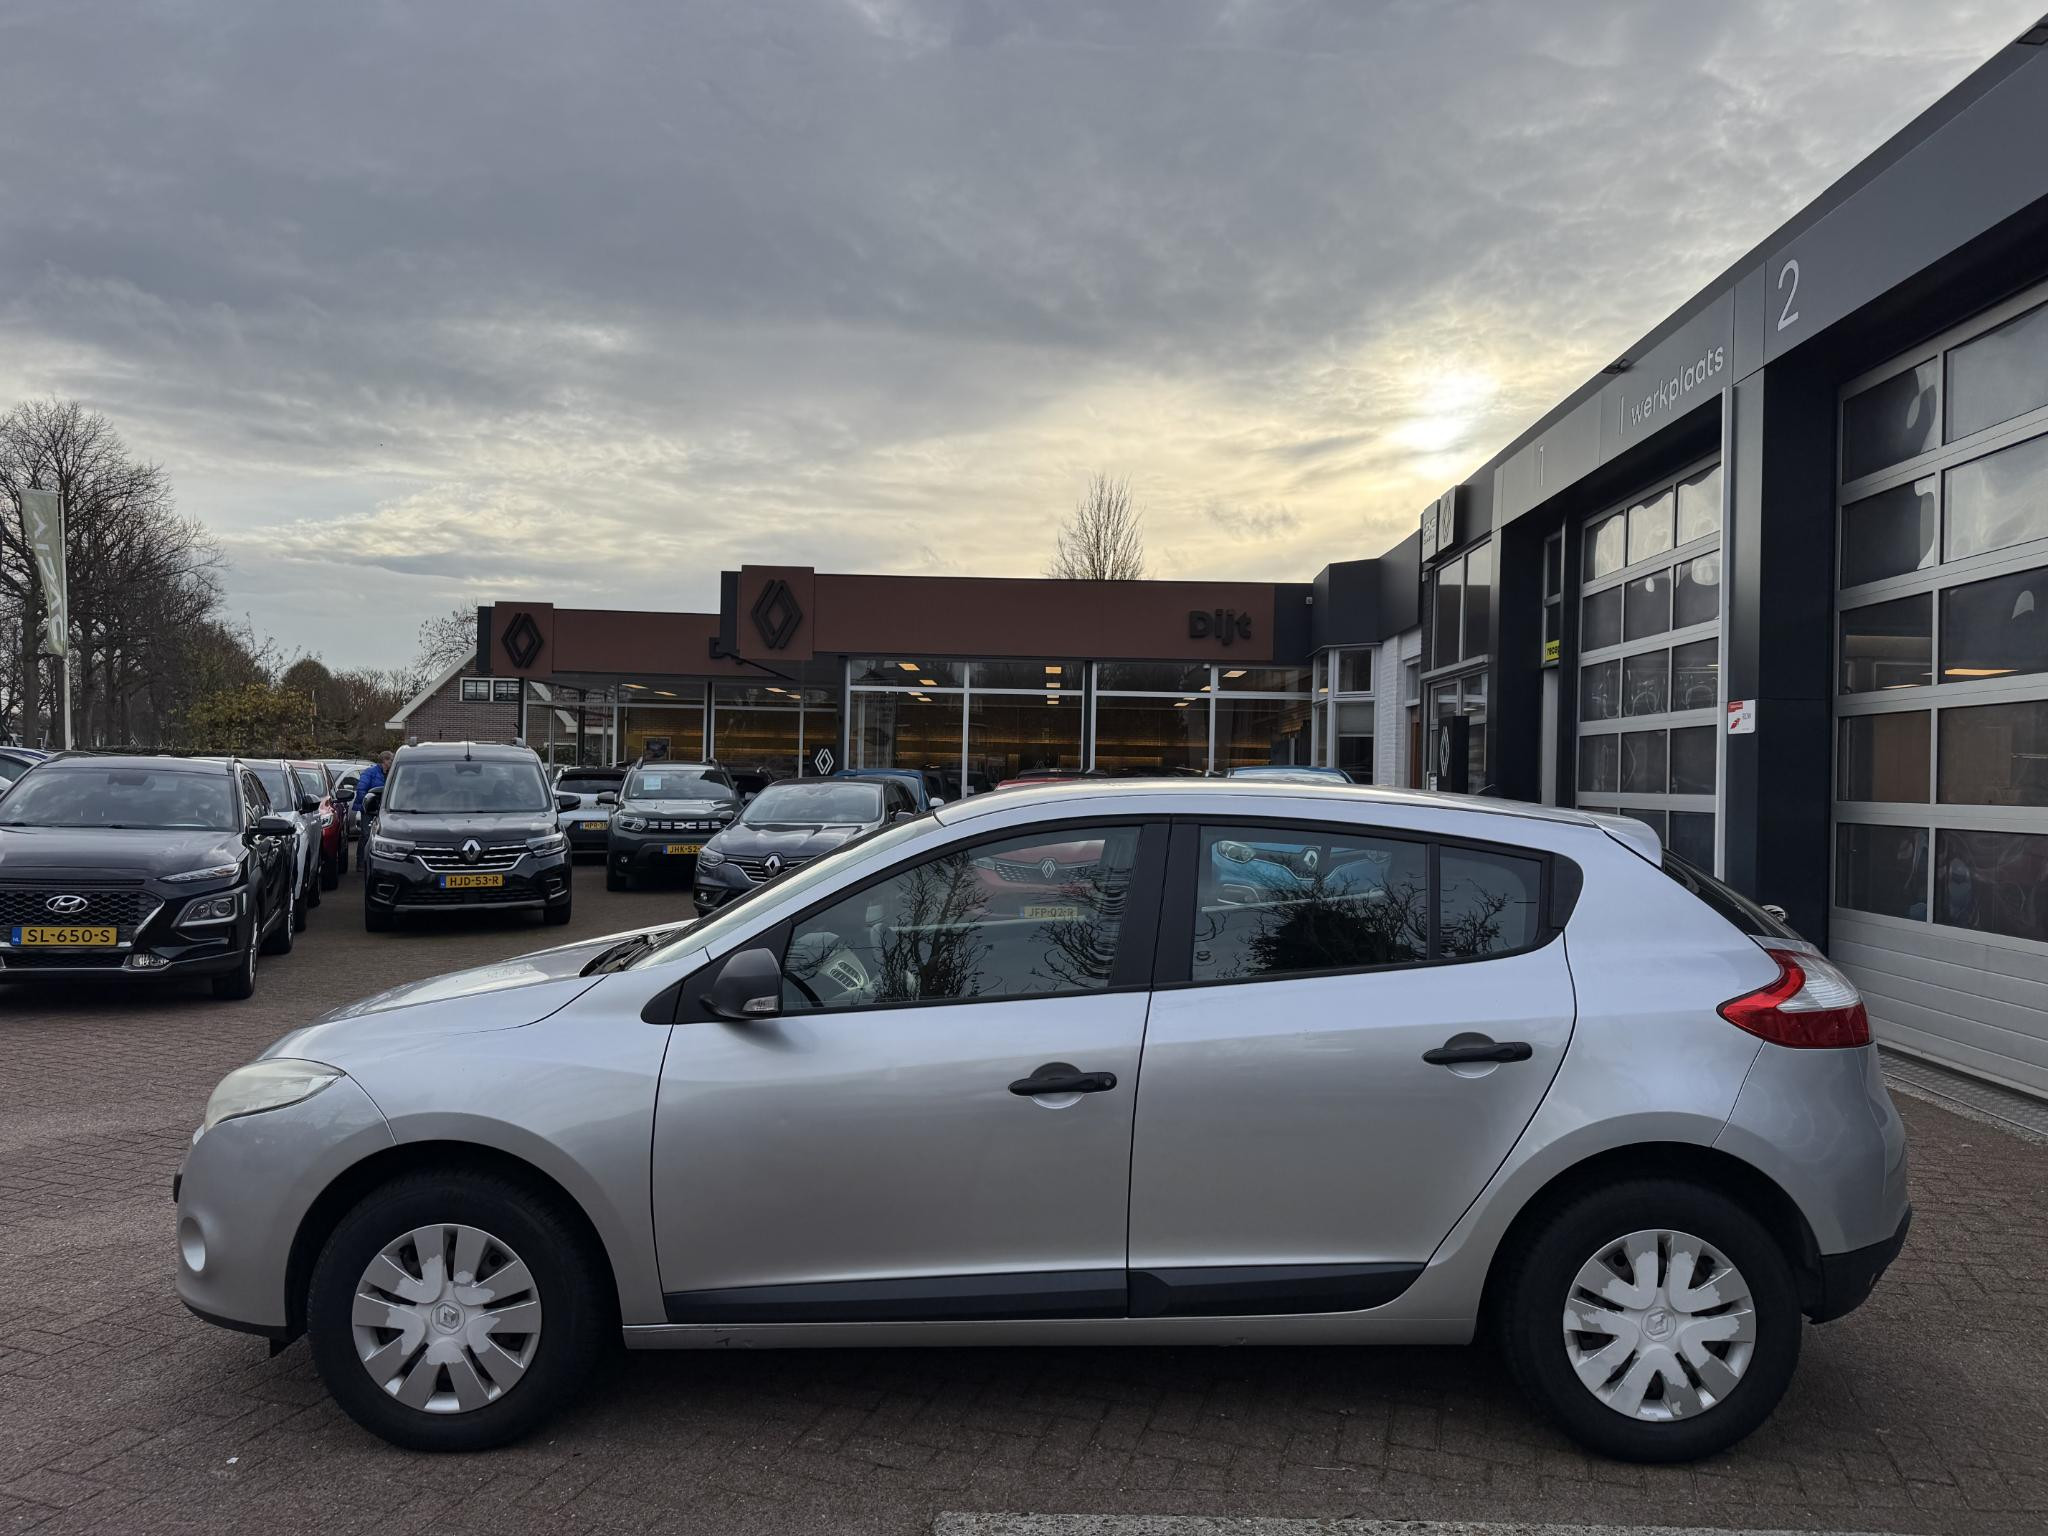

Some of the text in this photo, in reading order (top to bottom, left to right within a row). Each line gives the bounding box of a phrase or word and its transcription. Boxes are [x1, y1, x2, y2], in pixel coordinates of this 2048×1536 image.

[1777, 259, 1800, 332] 2
[1630, 346, 1724, 426] werkplaats
[1189, 608, 1252, 646] Dijt
[669, 845, 702, 854] JHK-52-
[450, 877, 499, 887] HJD-53-R
[27, 929, 111, 943] SL-650-S
